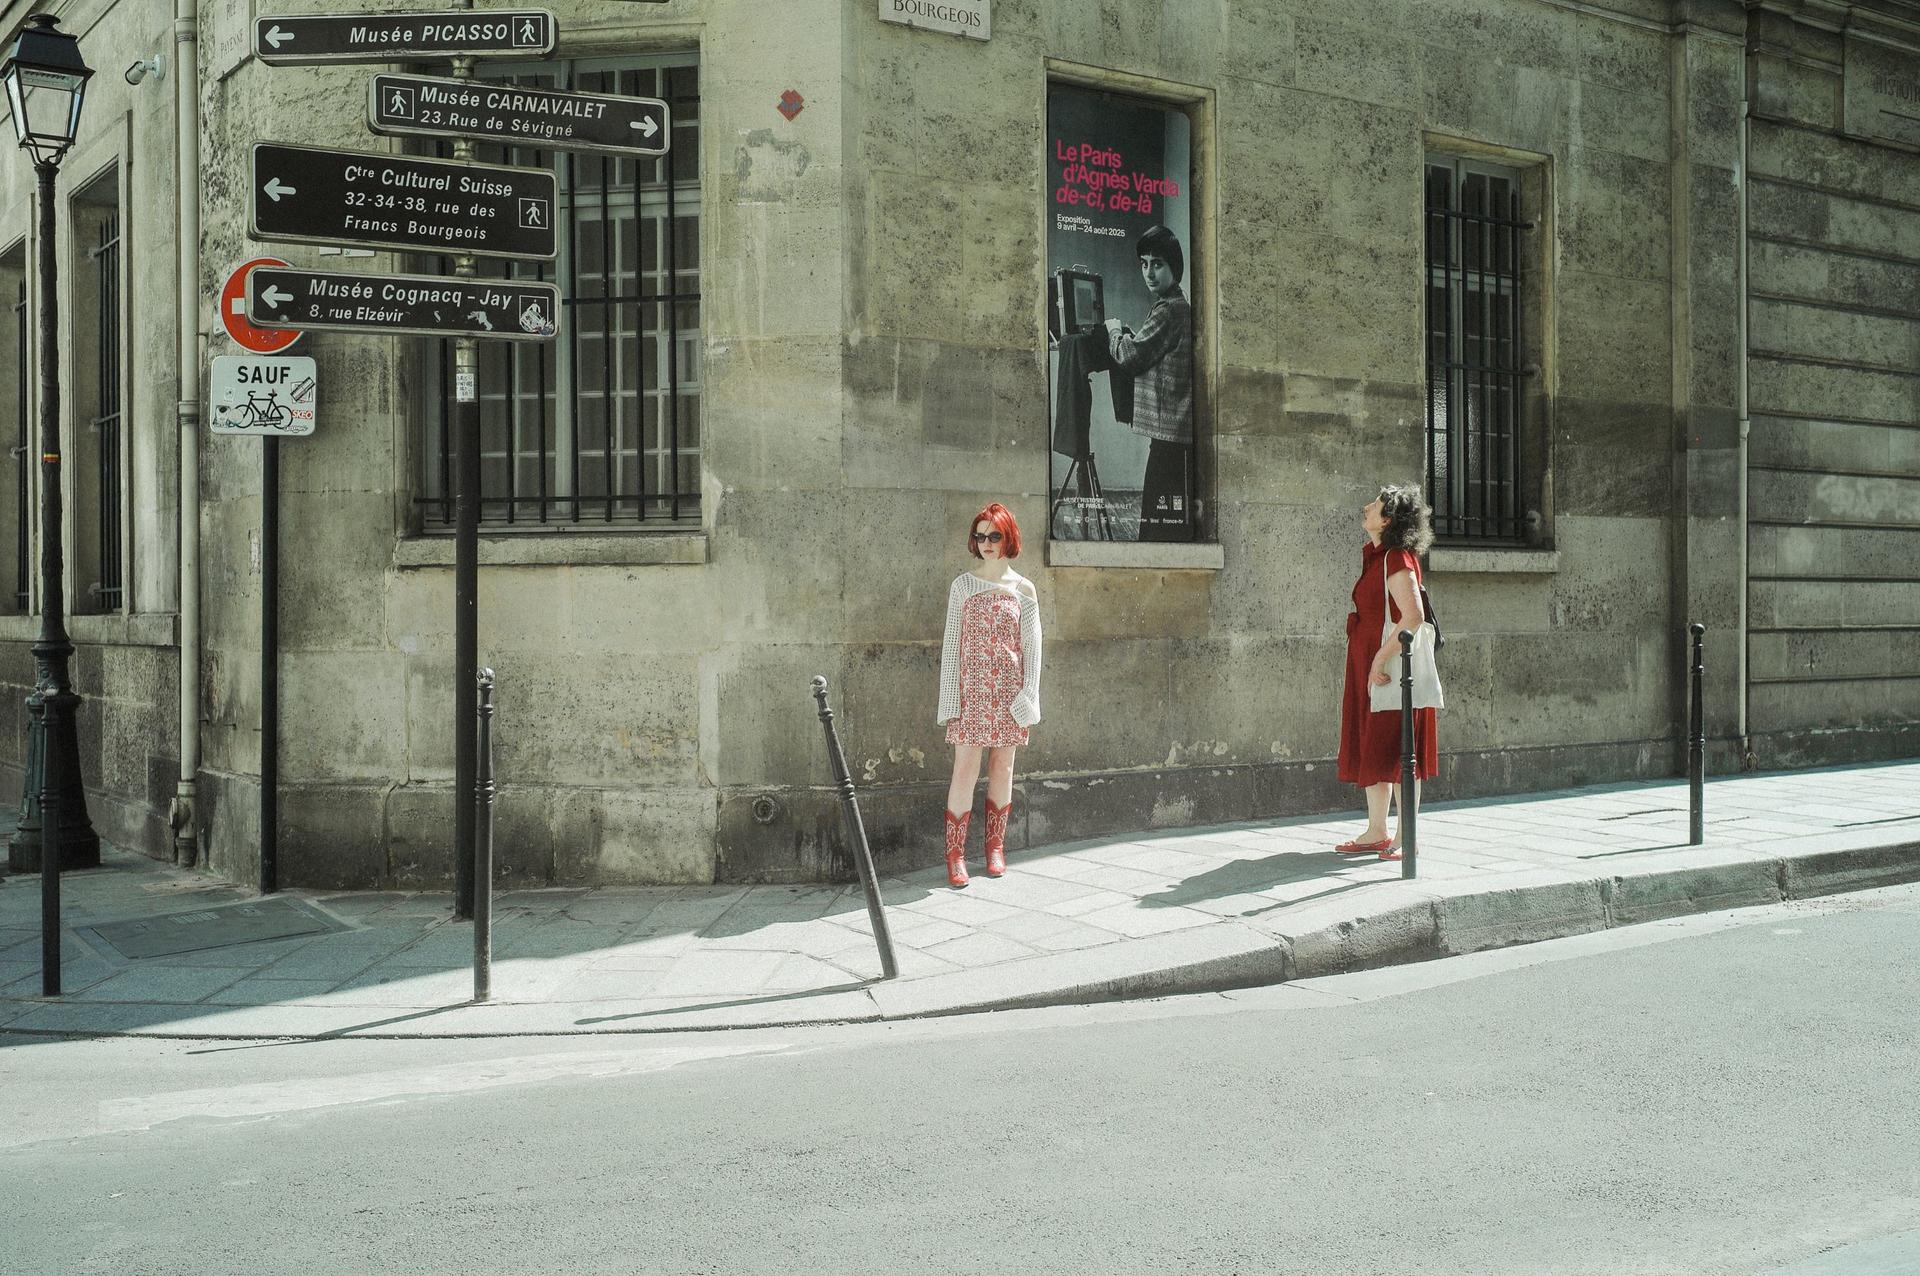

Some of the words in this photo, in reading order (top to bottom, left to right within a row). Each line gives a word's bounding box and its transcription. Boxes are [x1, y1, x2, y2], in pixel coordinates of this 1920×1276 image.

[893, 0, 981, 27] BOURGEOIS
[350, 25, 413, 44] Musée
[421, 24, 508, 42] PICASSO
[420, 86, 480, 107] Musée
[486, 92, 607, 119] CARNAVALET
[485, 116, 503, 130] de
[511, 118, 573, 138] Sévigné
[1056, 139, 1078, 162] Le
[1080, 143, 1122, 169] Paris
[381, 168, 451, 192] Culturel
[459, 176, 513, 197] Suisse
[1062, 164, 1131, 191] d'Agnès
[1132, 172, 1181, 198] Varda
[434, 202, 460, 215] rue
[469, 203, 496, 218] des
[1055, 184, 1105, 213] de-ci,
[1109, 190, 1153, 214] de-là
[344, 215, 398, 233] Francs
[407, 220, 487, 241] Bourgeois
[1056, 221, 1063, 230] 9
[1063, 223, 1077, 232] avril
[1083, 225, 1093, 233] 24
[1093, 226, 1108, 236] août
[1108, 227, 1126, 238] 2025
[1057, 213, 1091, 225] Exposition
[309, 279, 374, 299] Musée
[382, 284, 462, 307] Cognacq
[479, 289, 513, 310] Jay
[309, 304, 324, 319] 8,
[328, 307, 353, 320] rue
[355, 306, 404, 323] Elzévir
[237, 365, 291, 385] SAUF
